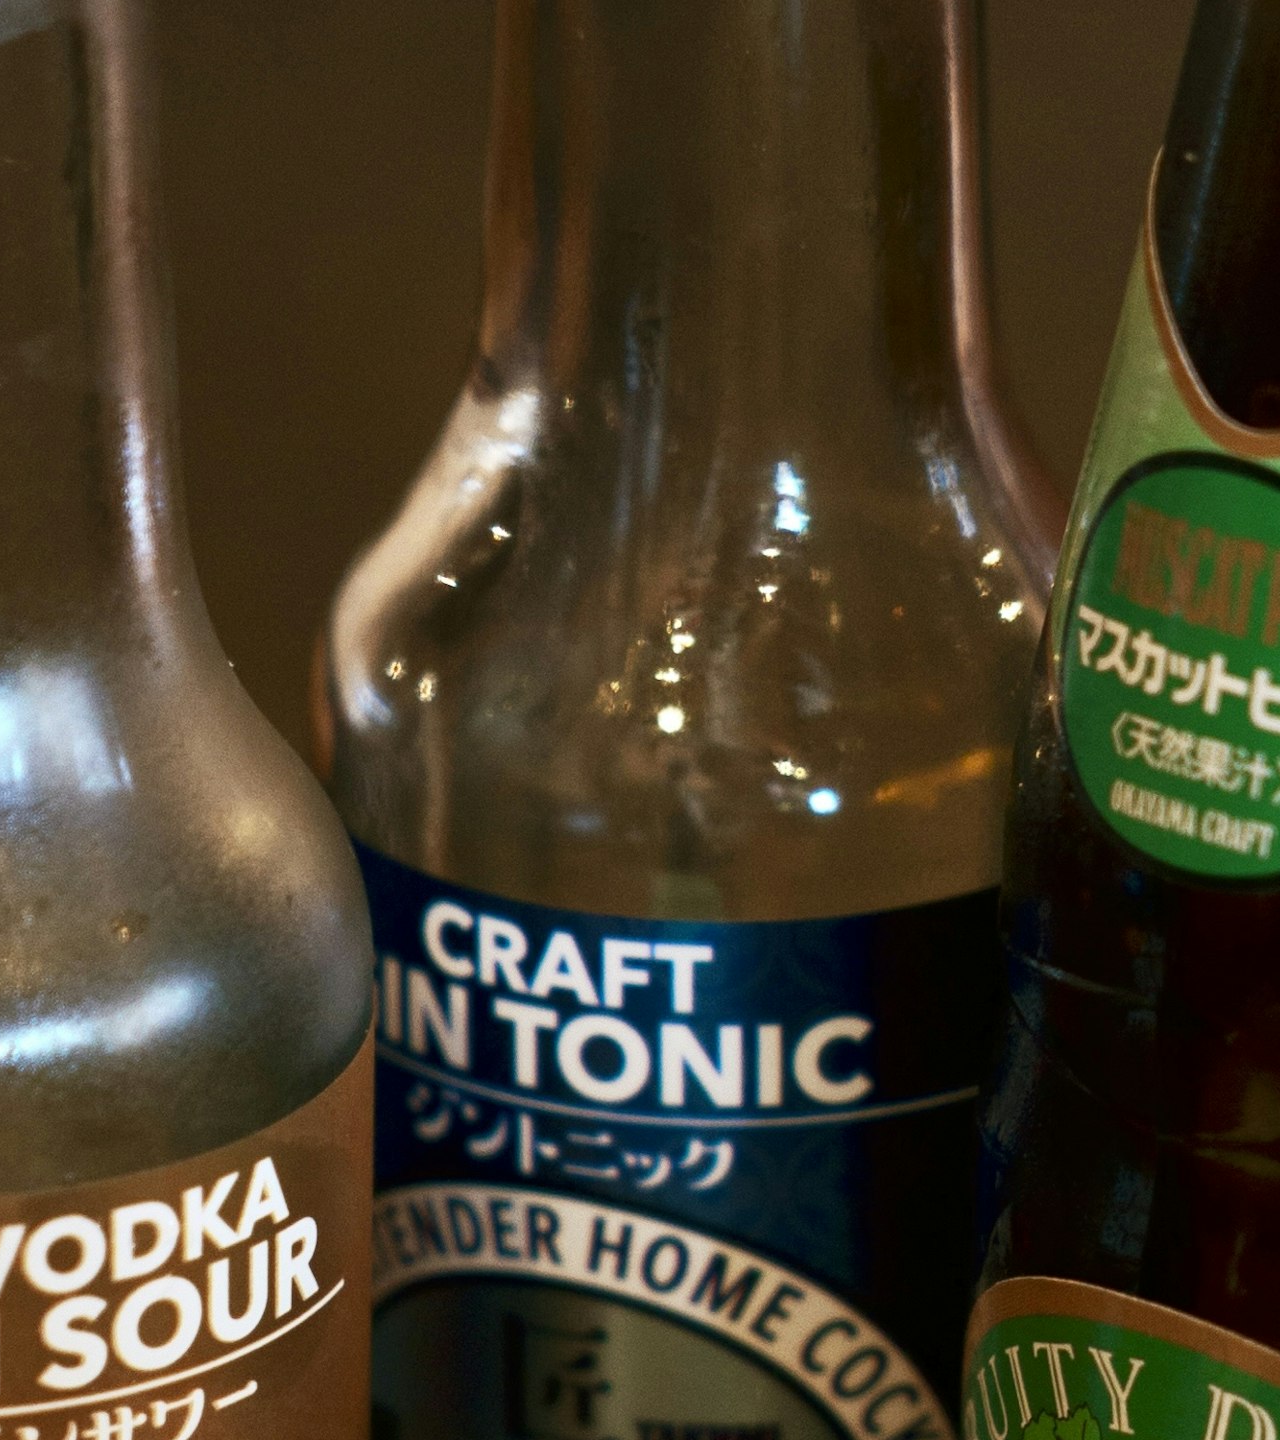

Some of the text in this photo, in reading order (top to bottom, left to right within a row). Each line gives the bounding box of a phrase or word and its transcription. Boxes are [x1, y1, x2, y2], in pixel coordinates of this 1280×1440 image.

[1201, 806, 1279, 861] CRAFT
[423, 900, 715, 1015] CRAFT
[380, 956, 877, 1110] IN TONIC
[406, 1082, 735, 1194] ジントニック
[36, 1215, 322, 1392] SOUR
[586, 1212, 809, 1344] HOME
